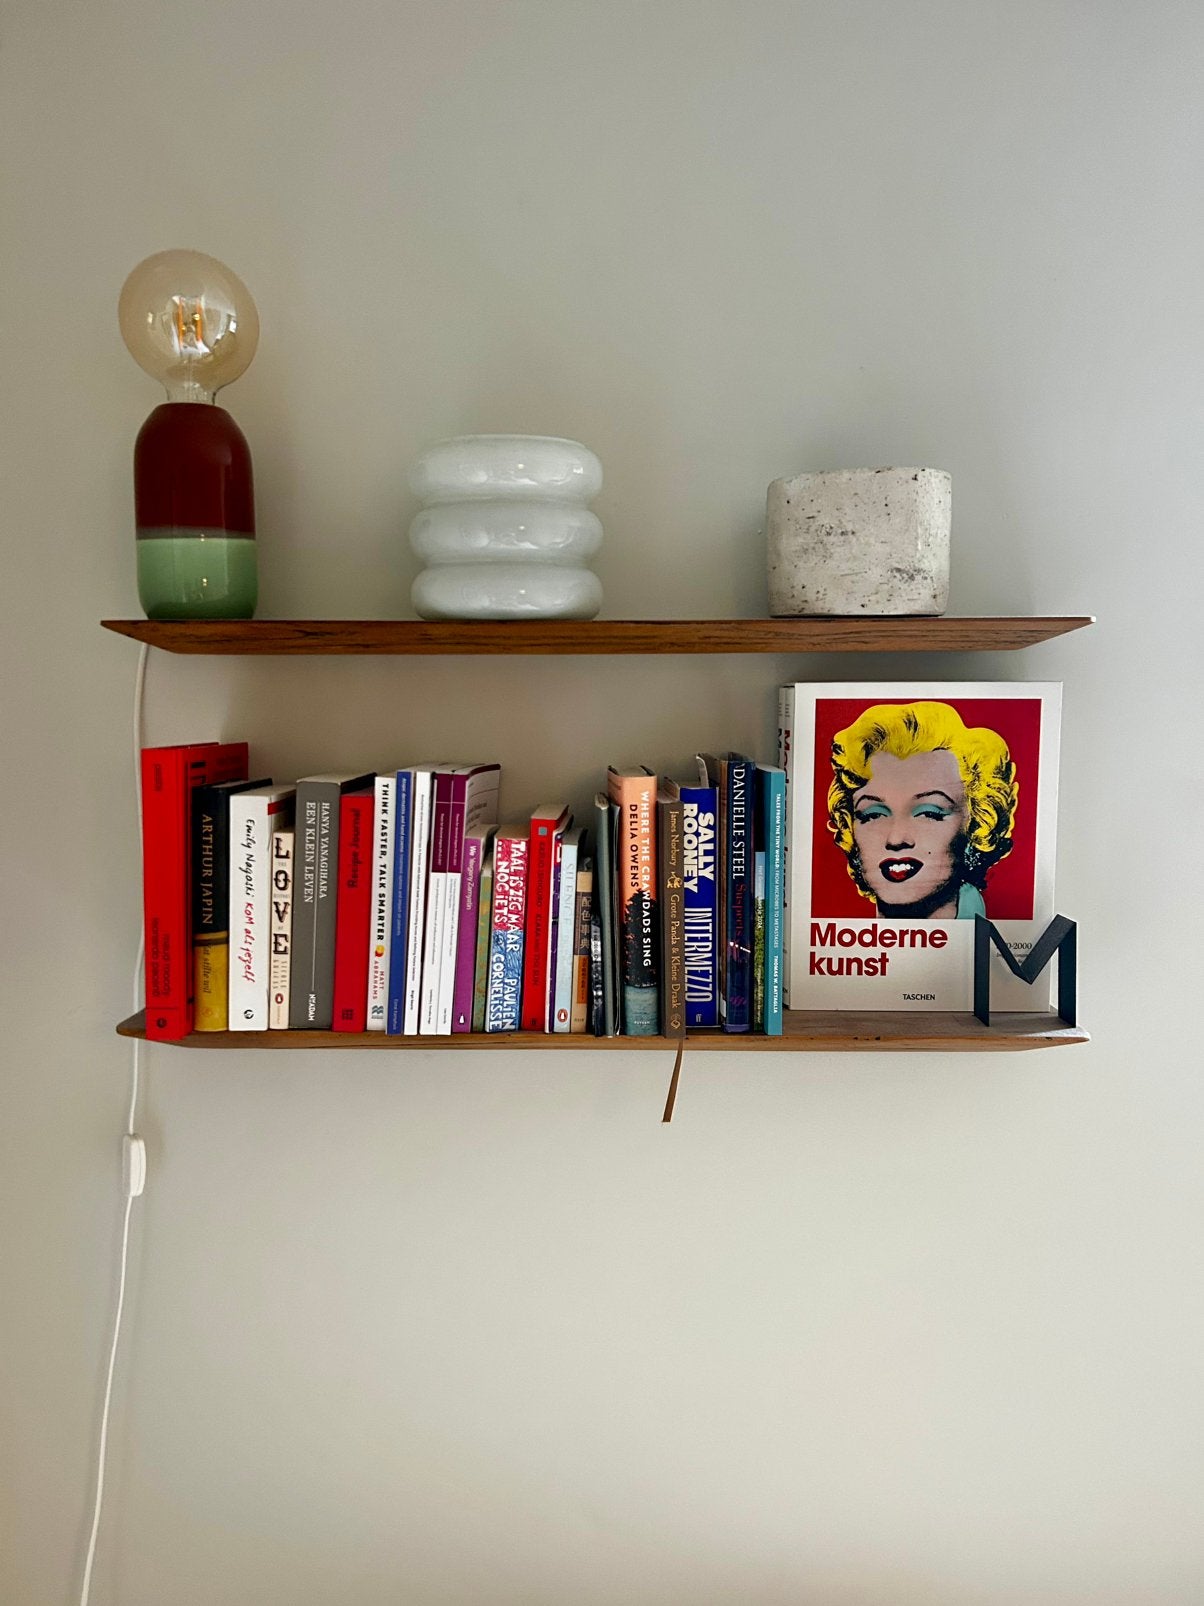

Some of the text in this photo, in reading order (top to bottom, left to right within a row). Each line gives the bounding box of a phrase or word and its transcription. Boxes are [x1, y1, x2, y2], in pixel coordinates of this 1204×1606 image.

[732, 769, 746, 837] DANIELLE
[241, 819, 256, 849] Emily
[669, 811, 680, 833] James
[303, 802, 316, 904] EEN KLEIN LEVEN
[319, 802, 331, 899] HANYA YANAGIHARA
[377, 783, 390, 941] THINK FASTER, TALK SMARTER
[468, 846, 478, 857] We
[510, 841, 527, 872] TAAL
[629, 804, 640, 888] DELIA OWENS
[670, 834, 680, 866] Norbury
[683, 803, 698, 893] ROONEY
[698, 812, 715, 881] SALLY
[732, 841, 746, 880] STEEL
[200, 814, 213, 925] ARTHUR JAPIN
[239, 853, 256, 898] Nagoski
[497, 861, 510, 892] NOG
[641, 791, 652, 967] WHERE THE CRAWDADS SING
[508, 889, 523, 911] ZEG
[670, 894, 680, 919] Grote
[506, 914, 521, 953] MAAR
[671, 921, 680, 945] Panda
[810, 922, 948, 948] Moderne
[671, 956, 681, 981] Kleine
[684, 907, 713, 1003] INTERMEZZO
[809, 951, 889, 976] kunst
[672, 984, 681, 1009] Draak
[902, 993, 936, 1001] TASCHEN
